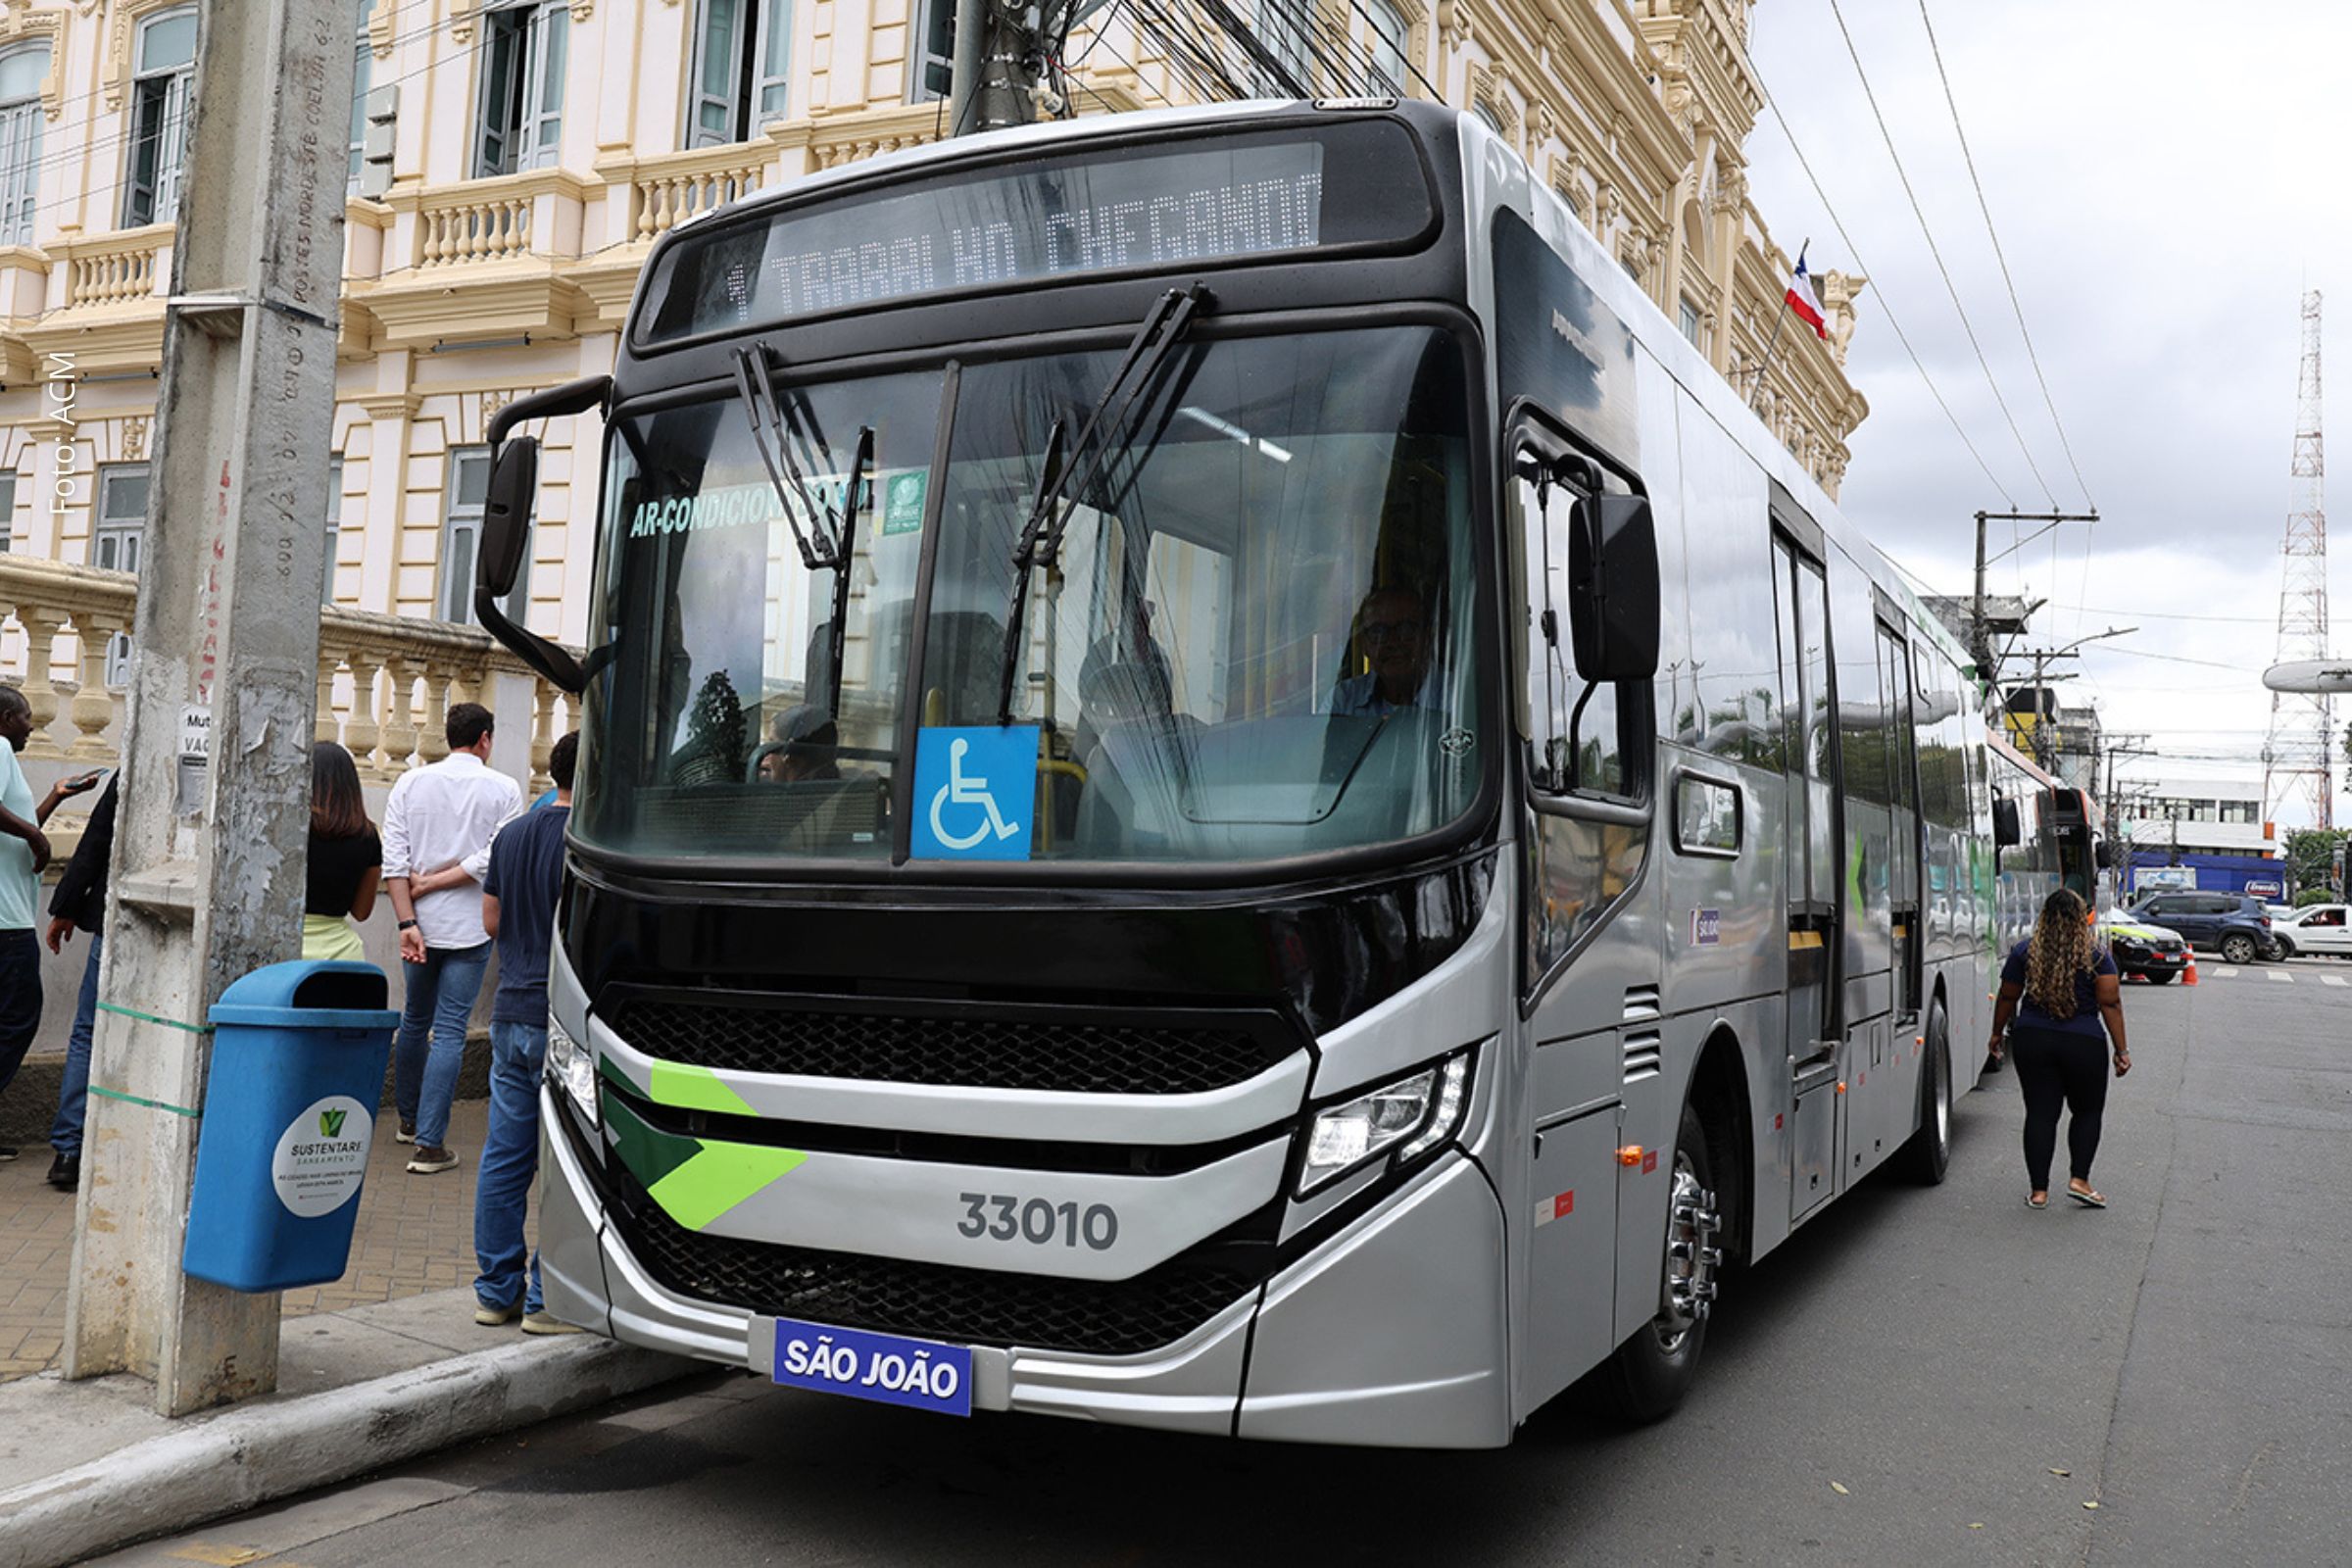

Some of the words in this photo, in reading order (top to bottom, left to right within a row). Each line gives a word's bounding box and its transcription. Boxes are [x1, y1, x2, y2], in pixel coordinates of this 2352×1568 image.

[956, 1192, 1119, 1250] 33010
[783, 1335, 858, 1383] SÃO
[860, 1348, 959, 1399] JOÃO
